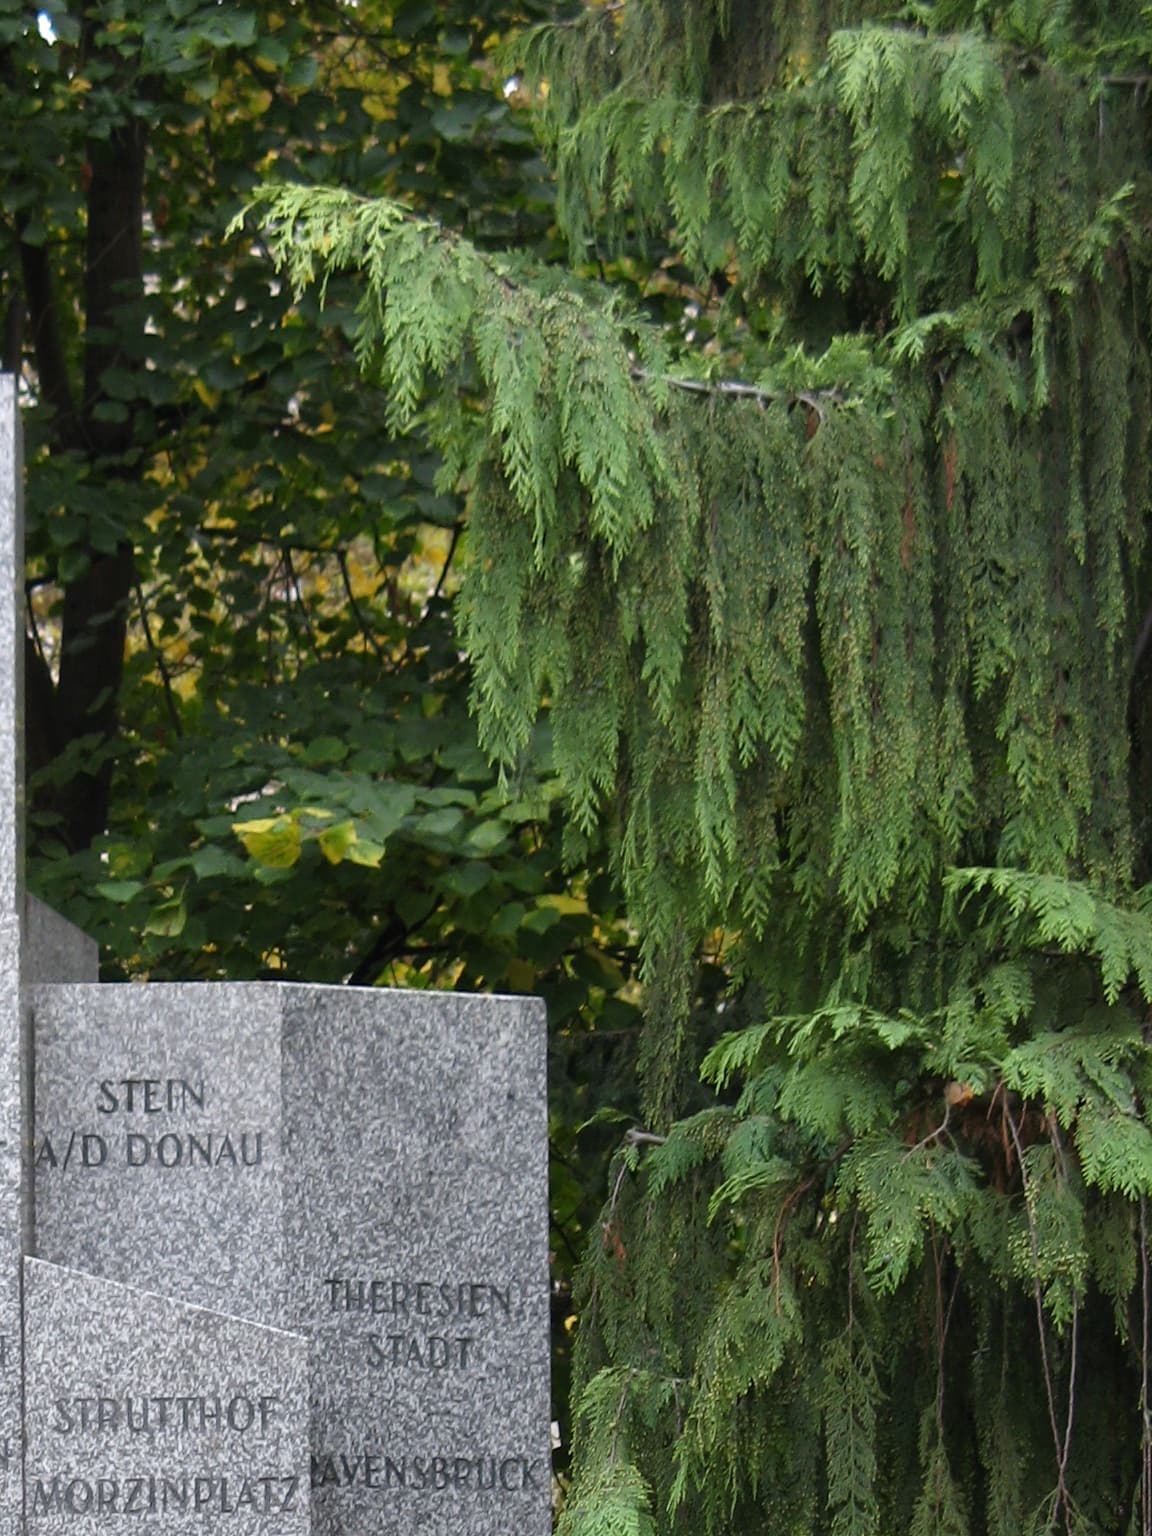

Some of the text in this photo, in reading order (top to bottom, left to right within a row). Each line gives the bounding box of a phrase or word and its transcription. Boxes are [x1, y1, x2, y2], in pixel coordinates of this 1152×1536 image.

[98, 1078, 205, 1114] STEIN
[35, 1131, 263, 1171] A/D DONAU
[324, 1278, 512, 1317] THERESIEN
[367, 1333, 474, 1369] STADT
[34, 1476, 301, 1514] MORZINPLATZ
